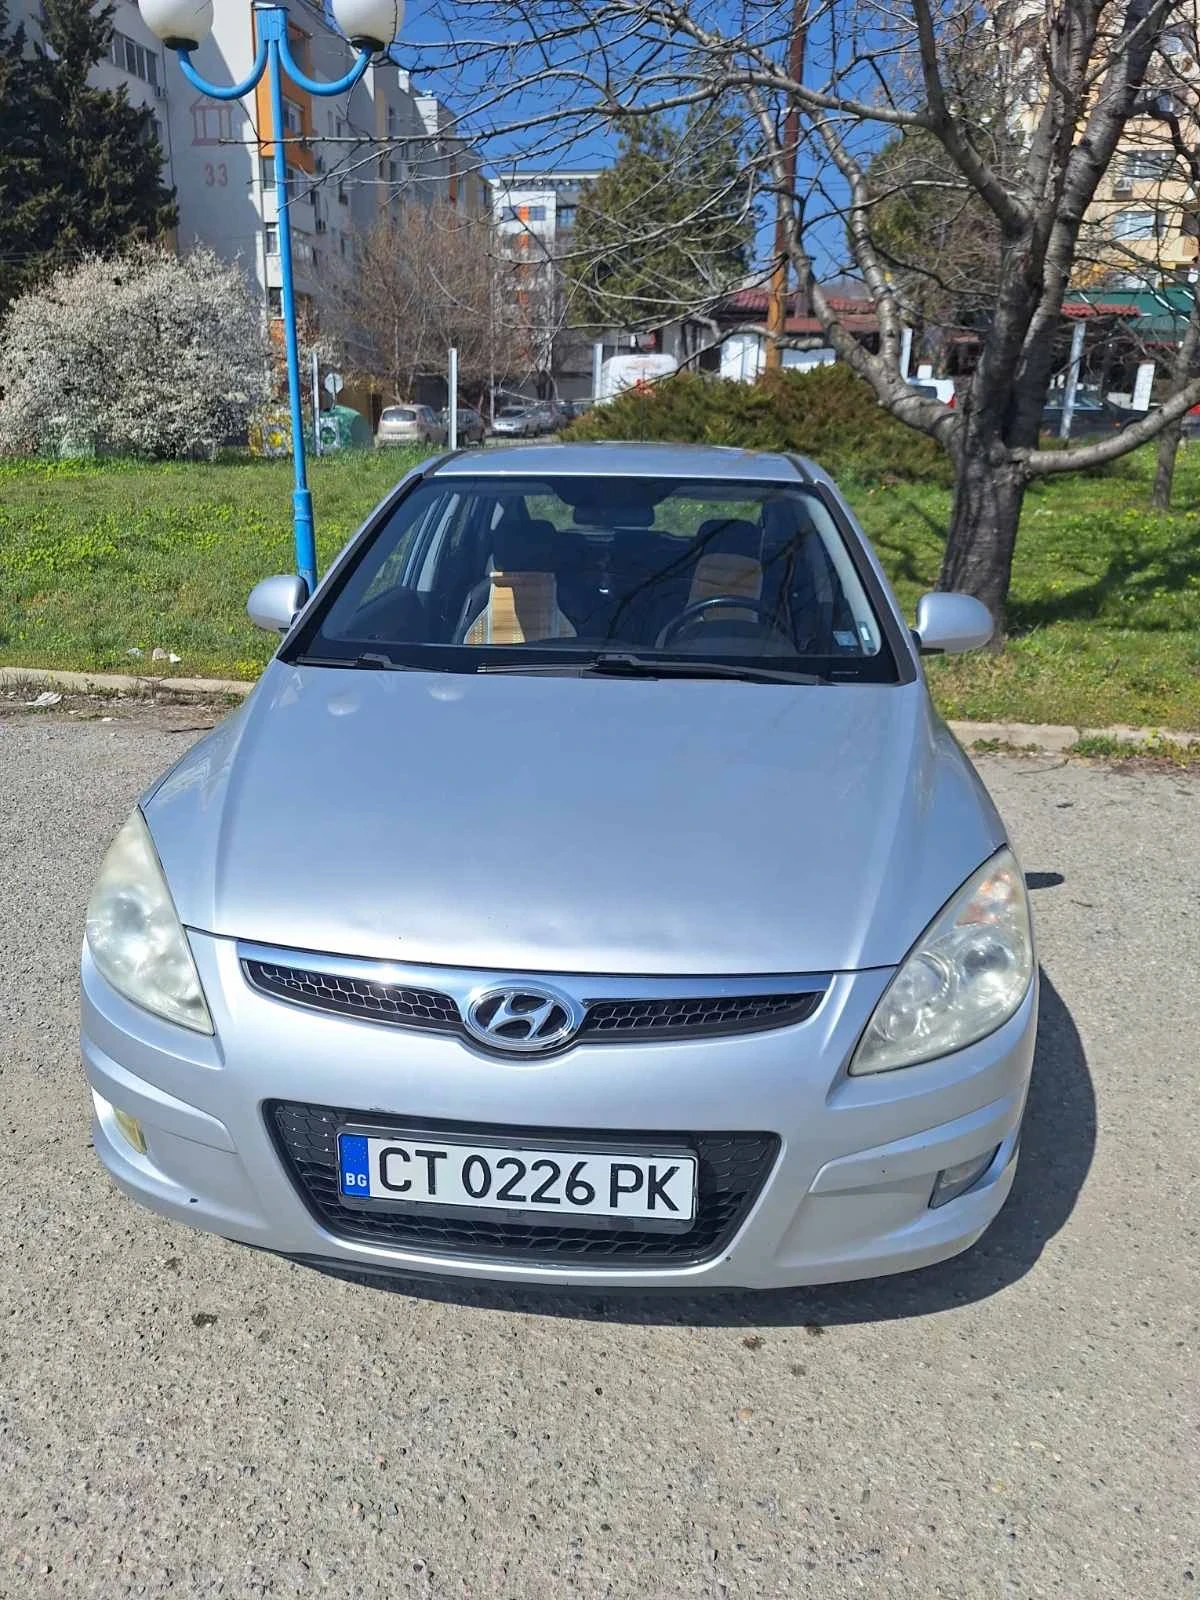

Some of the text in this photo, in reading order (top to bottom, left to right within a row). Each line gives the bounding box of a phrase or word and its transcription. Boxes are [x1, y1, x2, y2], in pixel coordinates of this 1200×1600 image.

[204, 161, 228, 187] 33
[345, 1172, 367, 1187] BG
[379, 1147, 681, 1212] CT 0226 PK
